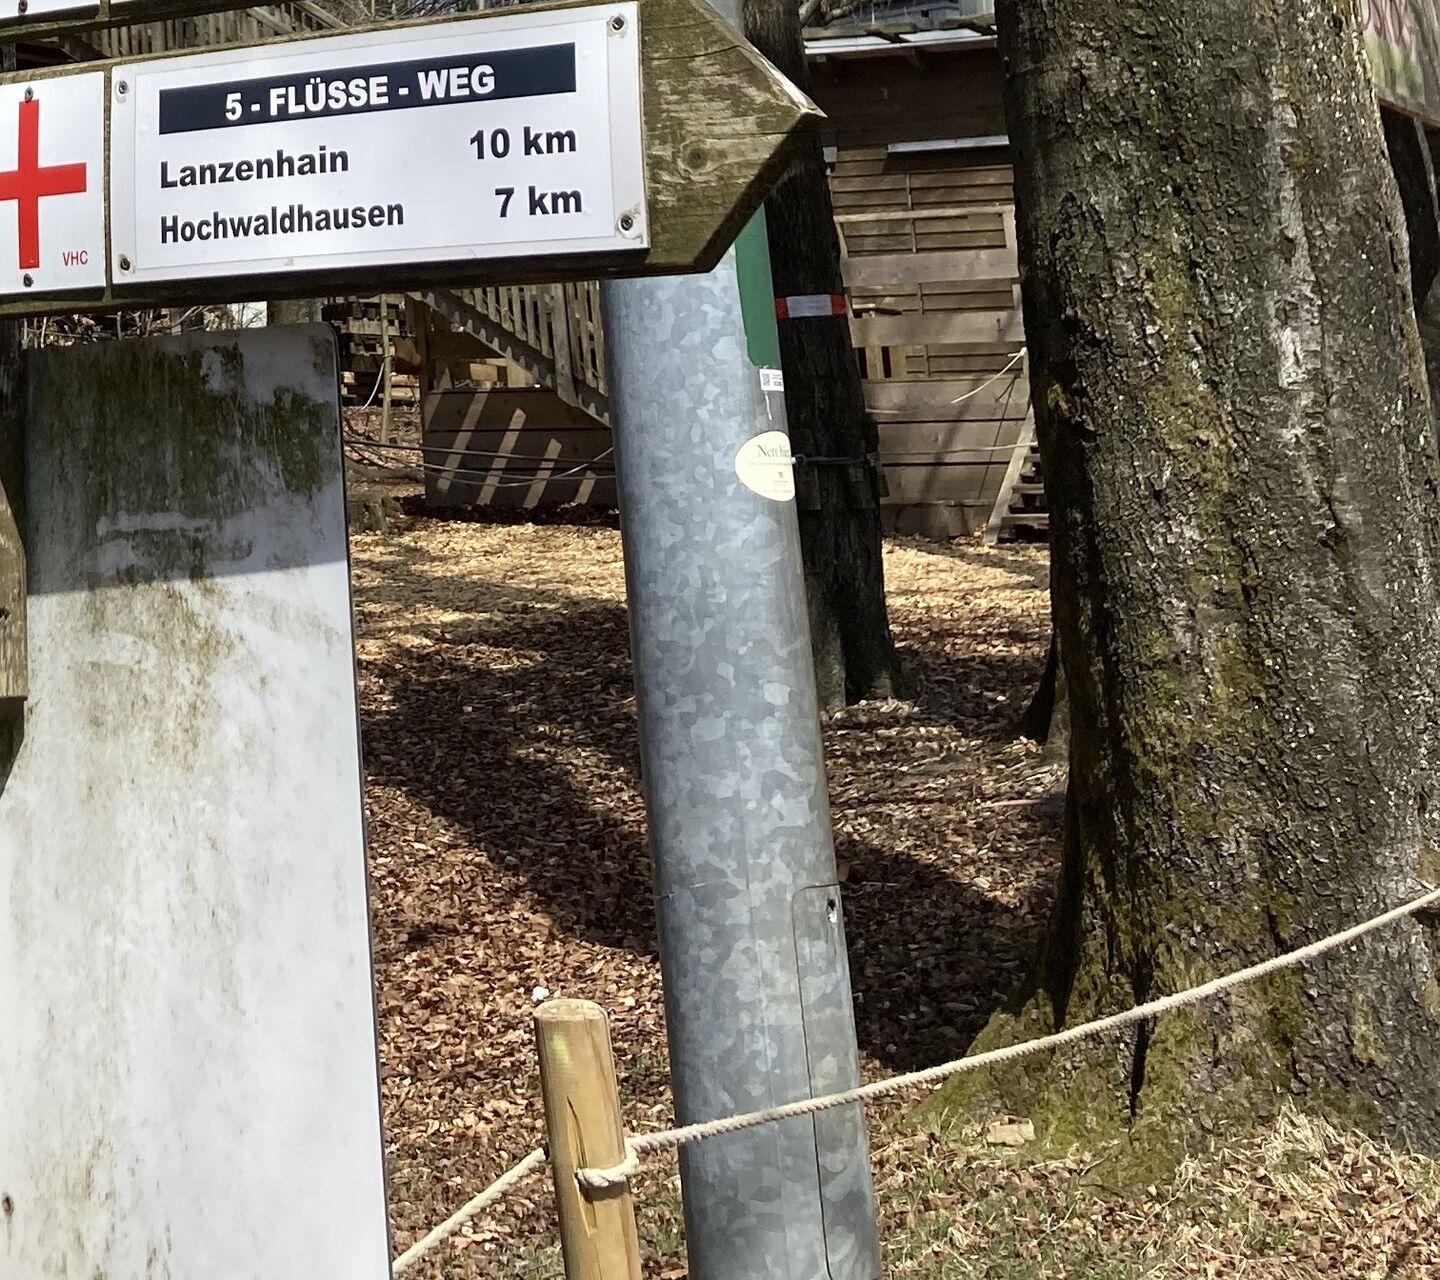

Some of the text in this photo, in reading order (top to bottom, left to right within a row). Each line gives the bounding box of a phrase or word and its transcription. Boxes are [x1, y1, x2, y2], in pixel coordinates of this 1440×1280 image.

[269, 75, 389, 117] FLÜSSE
[419, 65, 496, 101] WEG
[160, 123, 578, 189] Lanzenhain 10 km
[160, 184, 583, 244] Hochwaldhausen 7 km
[62, 250, 89, 266] VHC
